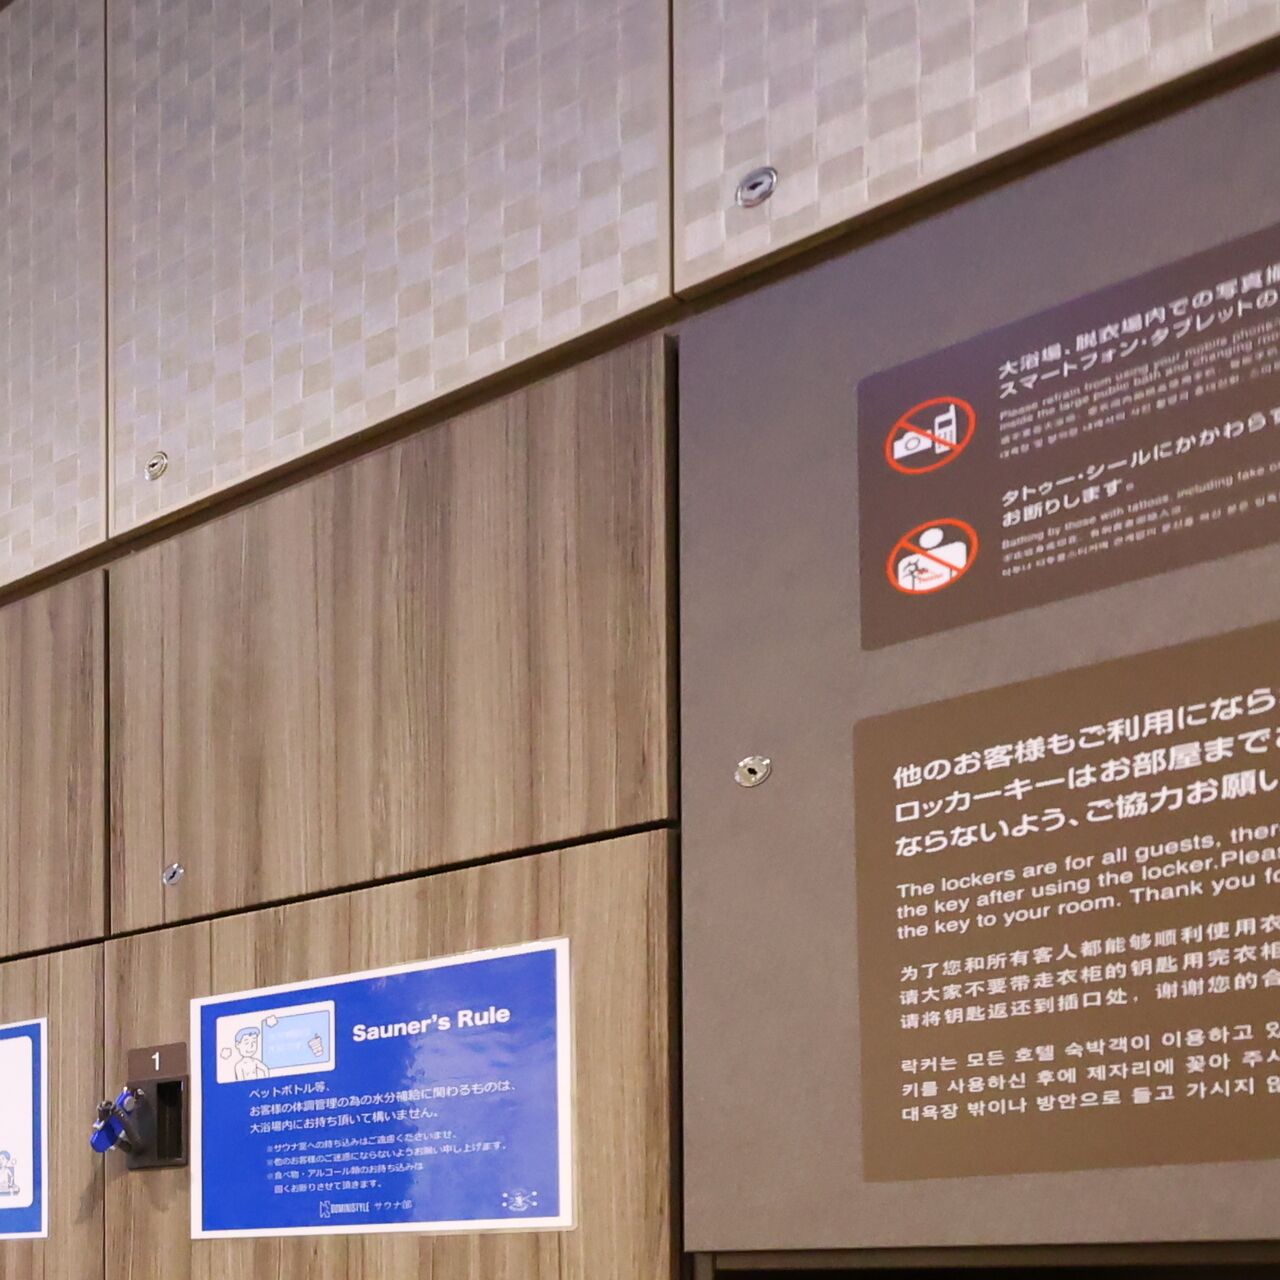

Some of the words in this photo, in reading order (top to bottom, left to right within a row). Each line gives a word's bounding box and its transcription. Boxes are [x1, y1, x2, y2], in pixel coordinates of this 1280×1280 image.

[999, 402, 1038, 420] Please
[1042, 387, 1080, 405] refrain
[1084, 377, 1111, 391] from
[1115, 364, 1148, 381] using
[1153, 352, 1179, 372] your
[999, 414, 1033, 431] inside
[1037, 407, 1055, 418] the
[1059, 395, 1089, 411] large
[1093, 382, 1129, 401] public
[1133, 370, 1161, 386] bath
[1165, 360, 1188, 376] and
[1193, 341, 1252, 366] changing
[1001, 531, 1044, 549] Bathing
[1047, 527, 1060, 536] by
[1064, 516, 1096, 530] those
[1100, 507, 1124, 520] with
[1177, 475, 1233, 498] including
[1237, 467, 1264, 480] fake
[1002, 479, 1133, 527] お断りします。
[893, 688, 1275, 789] 他のお客様もご利用になら
[895, 727, 1280, 822] ロッカーキーはお部屋まで
[896, 883, 935, 898] The
[941, 869, 1015, 891] lockers
[1022, 862, 1057, 878] are
[1064, 855, 1094, 870] for
[1101, 846, 1127, 865] all
[1134, 835, 1220, 863] guests,
[896, 904, 927, 919] the
[934, 897, 969, 913] key
[976, 888, 1024, 906] after
[1031, 878, 1090, 898] using
[1097, 871, 1133, 887] the
[897, 925, 928, 939] the
[934, 918, 970, 933] key
[976, 914, 996, 927] to
[1003, 905, 1050, 927] your
[1058, 895, 1120, 915] room.
[1129, 880, 1203, 904] Thank
[1211, 874, 1255, 896] you
[352, 1014, 450, 1041] Sauner's
[458, 1006, 510, 1027] Rule
[151, 1052, 159, 1070] 1
[901, 1056, 957, 1074] 락커는
[967, 1050, 1004, 1067] 모든
[1015, 1045, 1054, 1062] 호텔
[1064, 1034, 1149, 1057] 숙박객이
[1161, 1024, 1253, 1047] 이용하고
[249, 1081, 329, 1098] ペットボトル等、
[902, 1081, 937, 1097] 키를
[947, 1072, 1025, 1093] 사용하신
[1037, 1067, 1076, 1086] 후에
[1087, 1058, 1173, 1080] 제자리에
[902, 1103, 958, 1121] 대욕장
[967, 1097, 1027, 1116] 밖이나
[1036, 1089, 1120, 1111] 방안으로
[1131, 1085, 1174, 1104] 들고
[1186, 1077, 1254, 1098] 가시지
[250, 1108, 436, 1133] 大浴場内にお持ち頂いて構いません。
